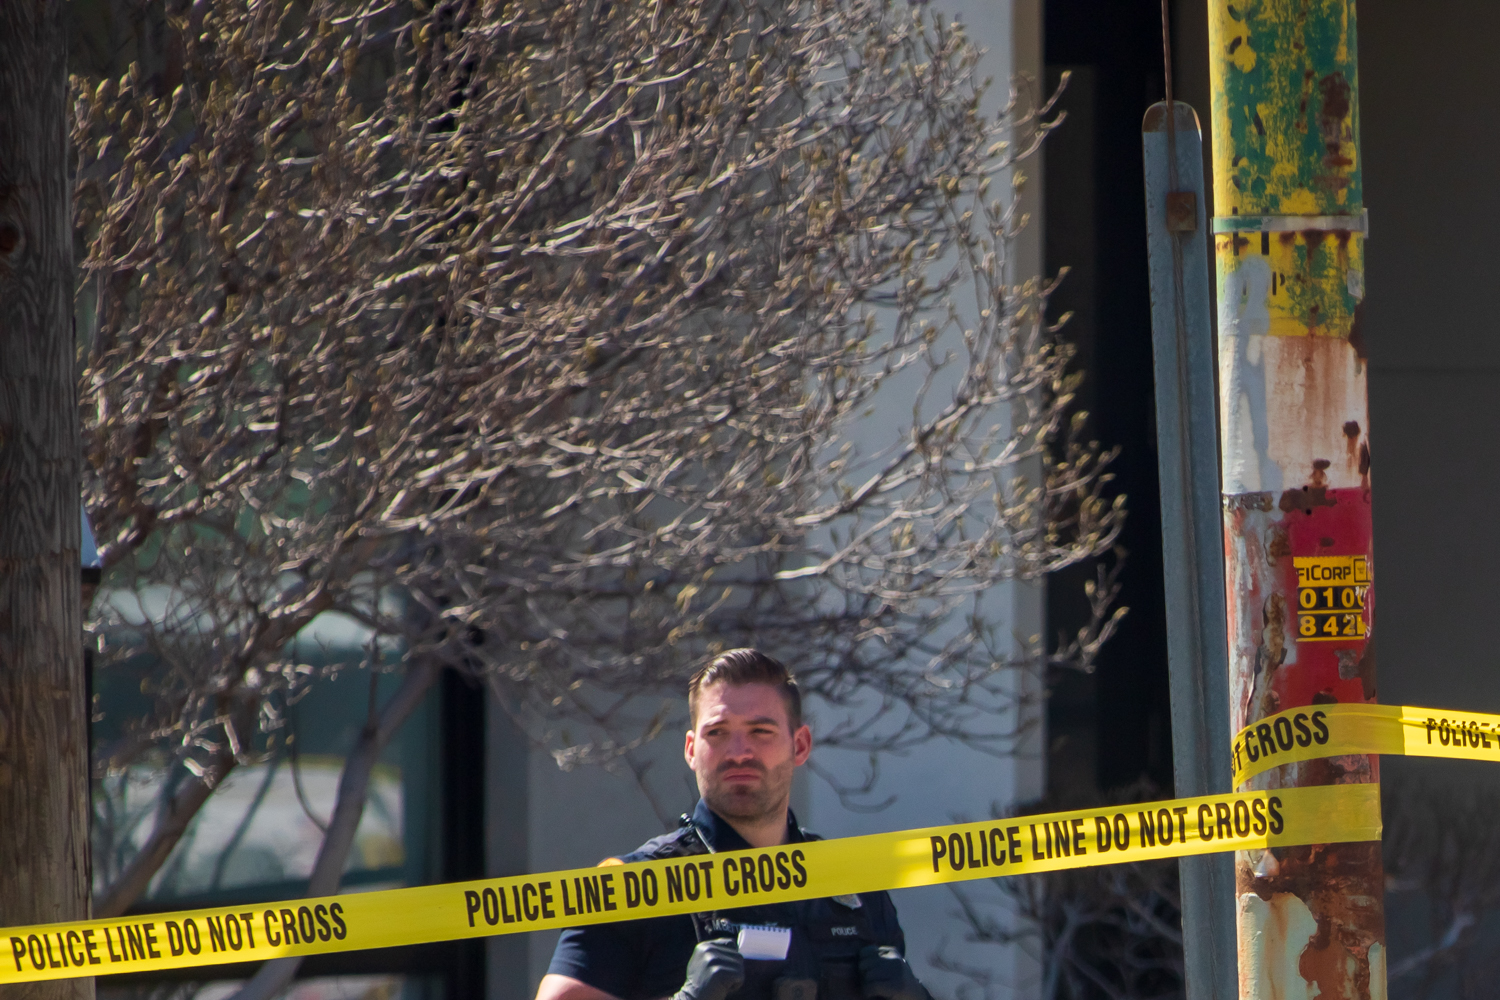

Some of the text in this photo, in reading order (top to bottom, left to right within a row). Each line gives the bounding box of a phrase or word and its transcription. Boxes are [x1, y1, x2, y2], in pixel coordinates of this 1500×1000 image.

[1245, 711, 1329, 763] CROSS
[930, 796, 1285, 873] POLICE LINE DO NOT CROSS
[465, 849, 808, 927] POLICE LINE DO NOT CROSS
[11, 902, 347, 972] POLICE LINE DO NOT CROSS
[831, 926, 859, 936] POLICE
